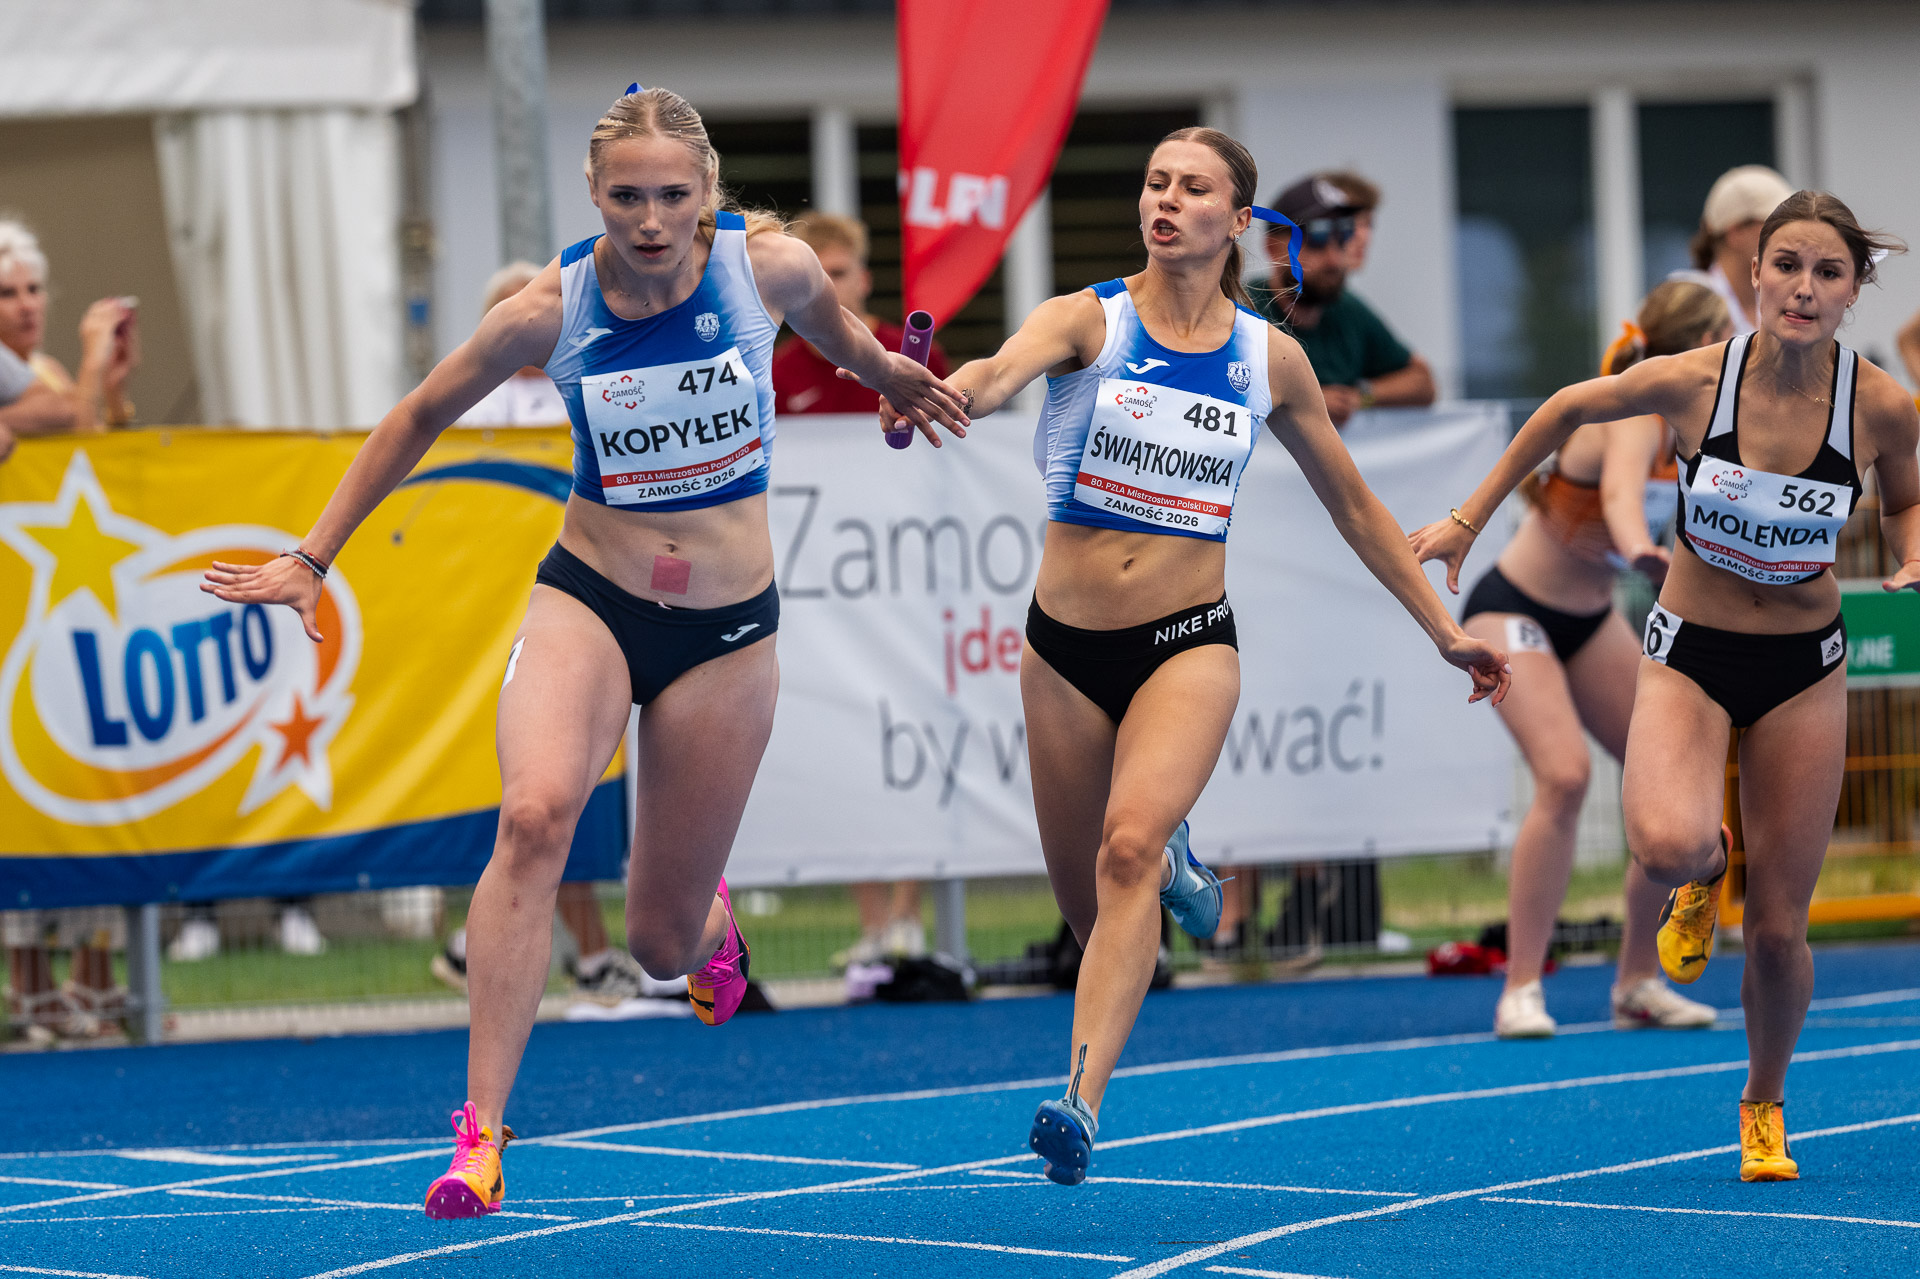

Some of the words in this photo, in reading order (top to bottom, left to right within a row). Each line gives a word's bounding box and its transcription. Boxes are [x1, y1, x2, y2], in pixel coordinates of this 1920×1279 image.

[611, 386, 643, 399] ZAMOŚĆ
[677, 361, 738, 396] 474
[1124, 396, 1153, 409] ZAMOŚĆ
[1183, 402, 1238, 437] 481
[600, 403, 753, 457] KOPYŁEK
[616, 475, 632, 485] 80.
[632, 474, 654, 483] PZLA
[655, 465, 710, 481] Mistrzostwa
[710, 456, 735, 471] Polski
[735, 446, 750, 459] U20
[1090, 425, 1234, 486] ŚWIĄTKOWSKA
[637, 479, 701, 498] ZAMOŚĆ
[704, 467, 736, 488] 2026
[1090, 477, 1104, 489] 80.
[1105, 482, 1125, 495] PZLA
[1126, 488, 1175, 506] Mistrzostwa
[1176, 499, 1201, 511] Polski
[1202, 504, 1219, 514] U20
[1719, 478, 1749, 492] ZAMOŚĆ
[1778, 484, 1836, 517] 562
[1103, 497, 1164, 521] ZAMOŚĆ
[1165, 512, 1199, 527] 2026
[1692, 504, 1829, 549] MOLENDA
[772, 485, 1048, 598] Zamo
[1709, 544, 1728, 554] PZLA
[1729, 550, 1777, 570] Mistrzostwa
[1778, 562, 1802, 571] Polski
[1804, 563, 1821, 571] U20
[1708, 554, 1765, 580] ZAMOŚĆ
[1767, 574, 1800, 582] 2026
[1154, 614, 1203, 645] NIKE
[1207, 598, 1229, 627] PRO
[1647, 612, 1668, 656] 6
[71, 602, 275, 749] LOTTO
[878, 696, 969, 809] by
